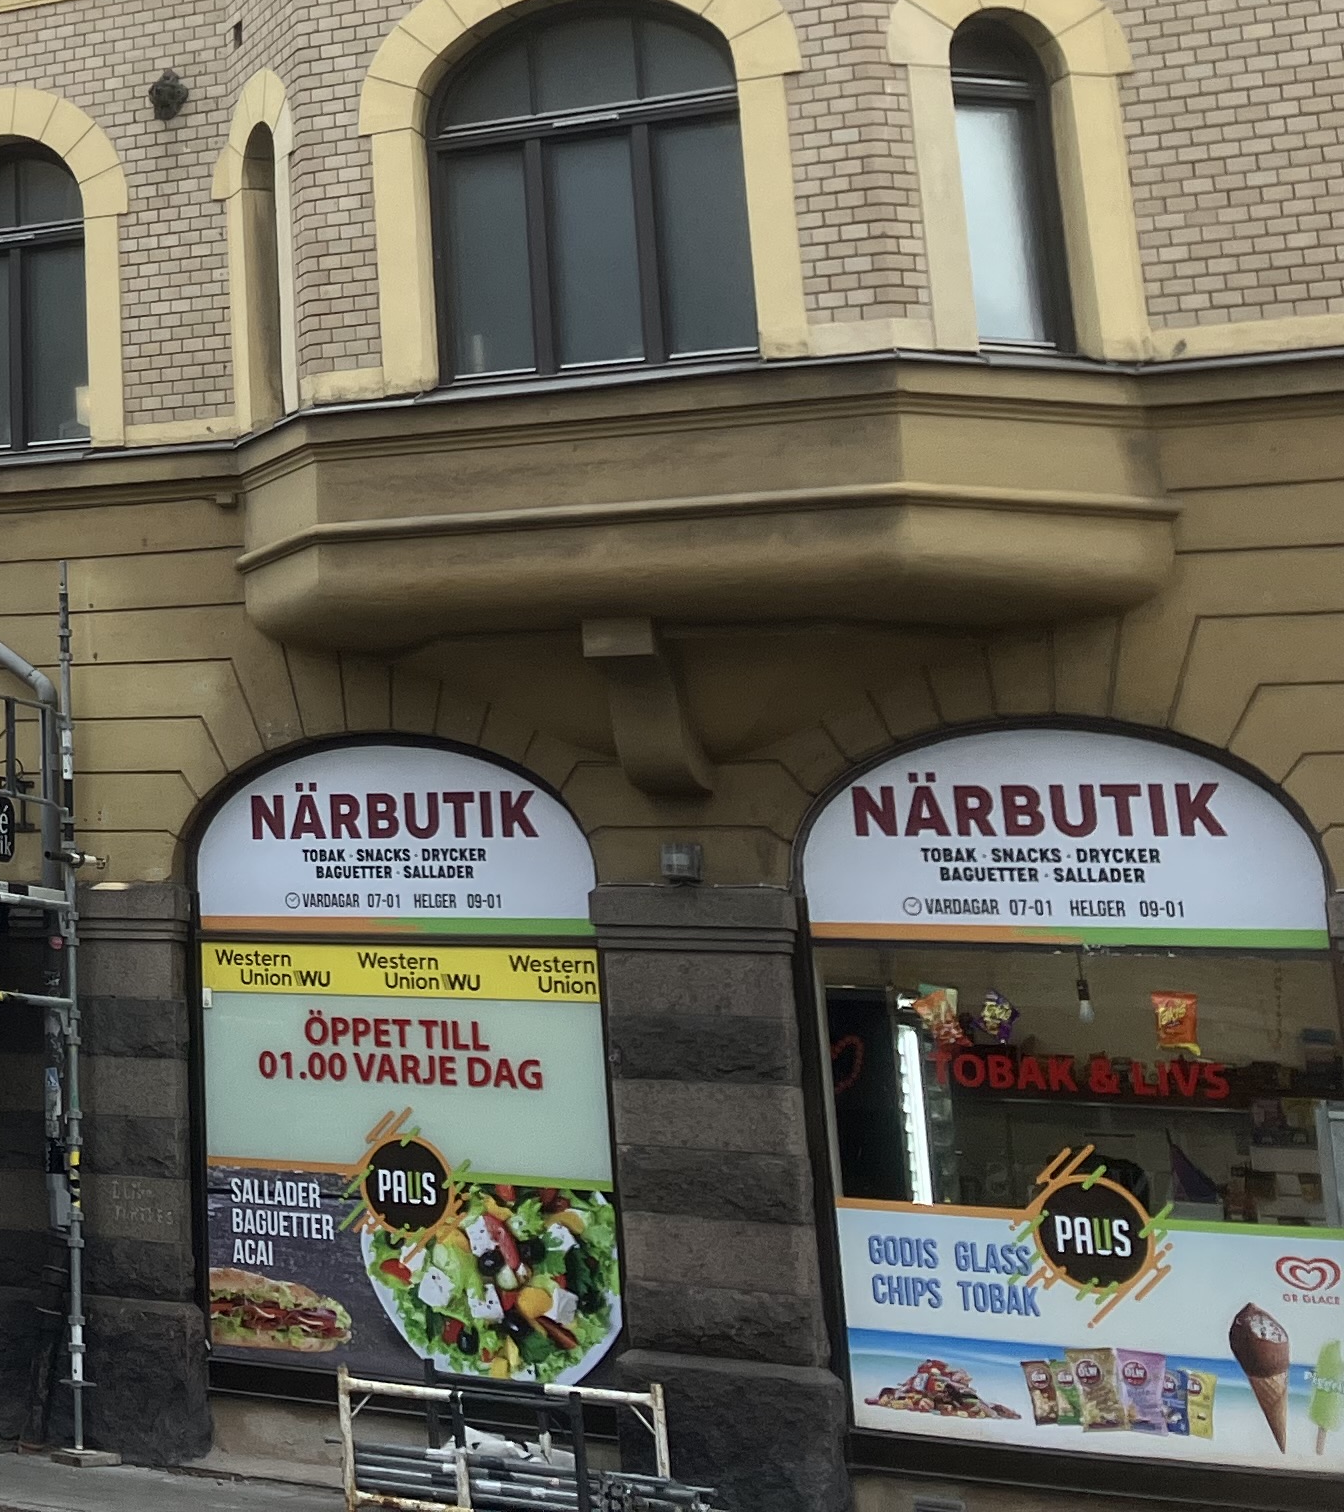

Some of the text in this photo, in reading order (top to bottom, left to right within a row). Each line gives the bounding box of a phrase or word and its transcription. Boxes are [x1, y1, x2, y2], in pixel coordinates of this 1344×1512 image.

[250, 782, 539, 840] NÄRBUTIK
[852, 772, 1227, 837] NÄRBUTIK
[302, 848, 487, 863] TOBAK SNACKS DRYCKER
[921, 848, 1161, 864] TOBAK SNACKS DRYCKER
[316, 865, 474, 880] BAGUETTER SALLADER
[940, 867, 1145, 883] BAGUETTER SALLADER
[302, 893, 502, 909] VARDAGAR 07-01 HELGER 09-01
[925, 898, 1185, 918] VARDAGAR 07-01 HELGER 09-01
[215, 949, 291, 967] Western
[357, 951, 438, 970] Western
[509, 955, 595, 974] Western
[240, 969, 292, 987] Union
[385, 972, 439, 990] Union
[538, 976, 596, 994] Union
[304, 1010, 490, 1052] ÖPPET TILL
[258, 1050, 543, 1090] 01.00 VARJE DAG
[926, 1050, 1230, 1100] TOBAK & LIVS
[231, 1178, 321, 1209] SALLADER
[378, 1170, 437, 1205] PAUS
[232, 1208, 334, 1240] BAGUETTER
[1055, 1215, 1132, 1257] PAUS
[233, 1239, 273, 1266] ACAI
[868, 1235, 1033, 1276] GODIS GLASS
[871, 1273, 1040, 1317] CHIPS TOBAK
